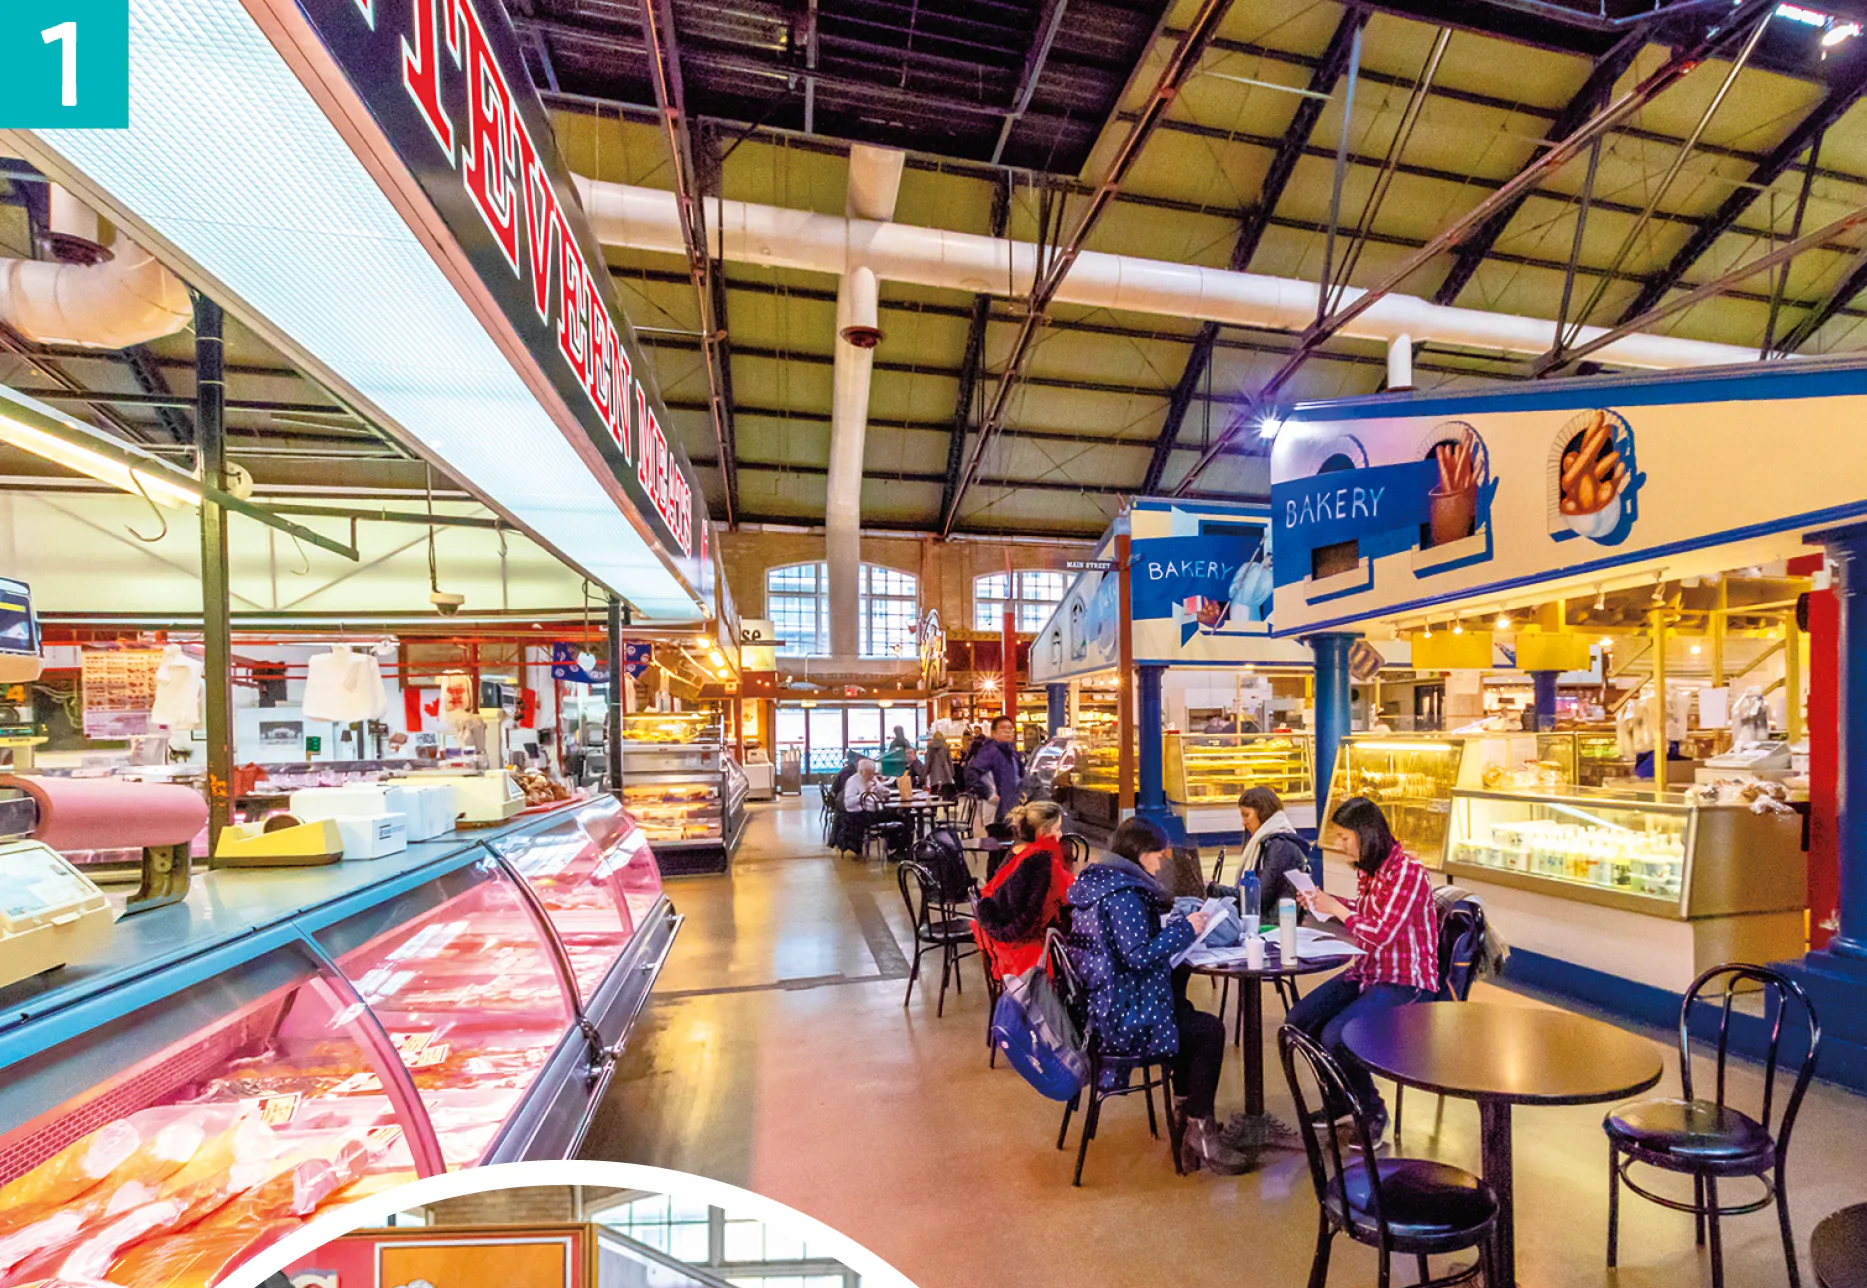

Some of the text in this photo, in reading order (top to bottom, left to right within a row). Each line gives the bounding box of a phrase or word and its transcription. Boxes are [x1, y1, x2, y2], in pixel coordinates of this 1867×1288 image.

[635, 378, 692, 560] MEATS
[1286, 486, 1385, 529] BAKERY
[1066, 561, 1111, 570] MAIN STREET
[1148, 560, 1234, 581] BAKERY
